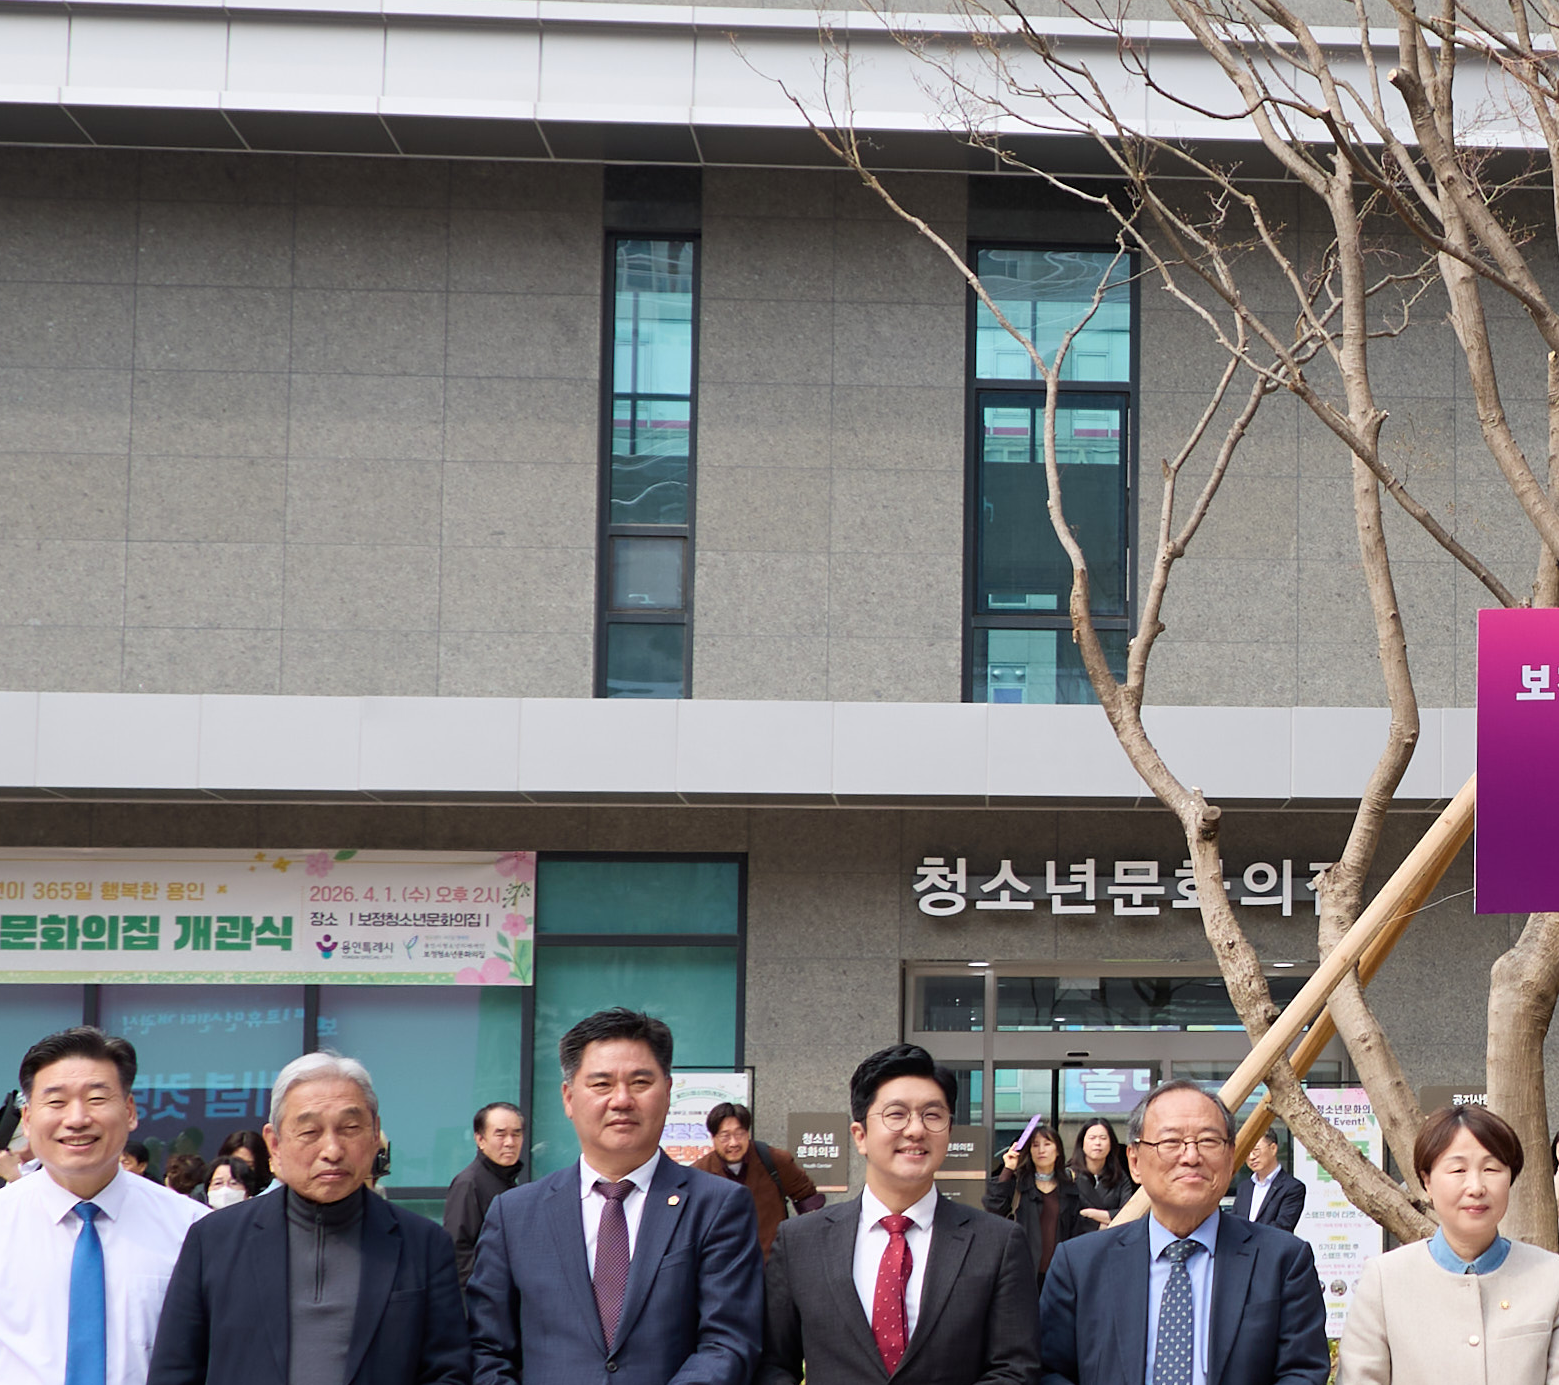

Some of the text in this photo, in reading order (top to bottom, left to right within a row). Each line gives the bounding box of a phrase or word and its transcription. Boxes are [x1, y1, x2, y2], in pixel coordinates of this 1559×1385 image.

[32, 881, 92, 901] 365일
[100, 881, 160, 901] 행복한
[166, 882, 205, 901] 용인
[309, 886, 358, 902] 2026.
[402, 886, 430, 903] (수)
[435, 887, 468, 903] 오후
[473, 887, 501, 904] 2시
[310, 912, 338, 926] 장소
[173, 915, 294, 951] 개관식
[341, 941, 394, 953] 용인특례시
[1333, 1117, 1365, 1126] Event!
[802, 1133, 834, 1145] 청소년
[796, 1145, 840, 1158] 문화의집
